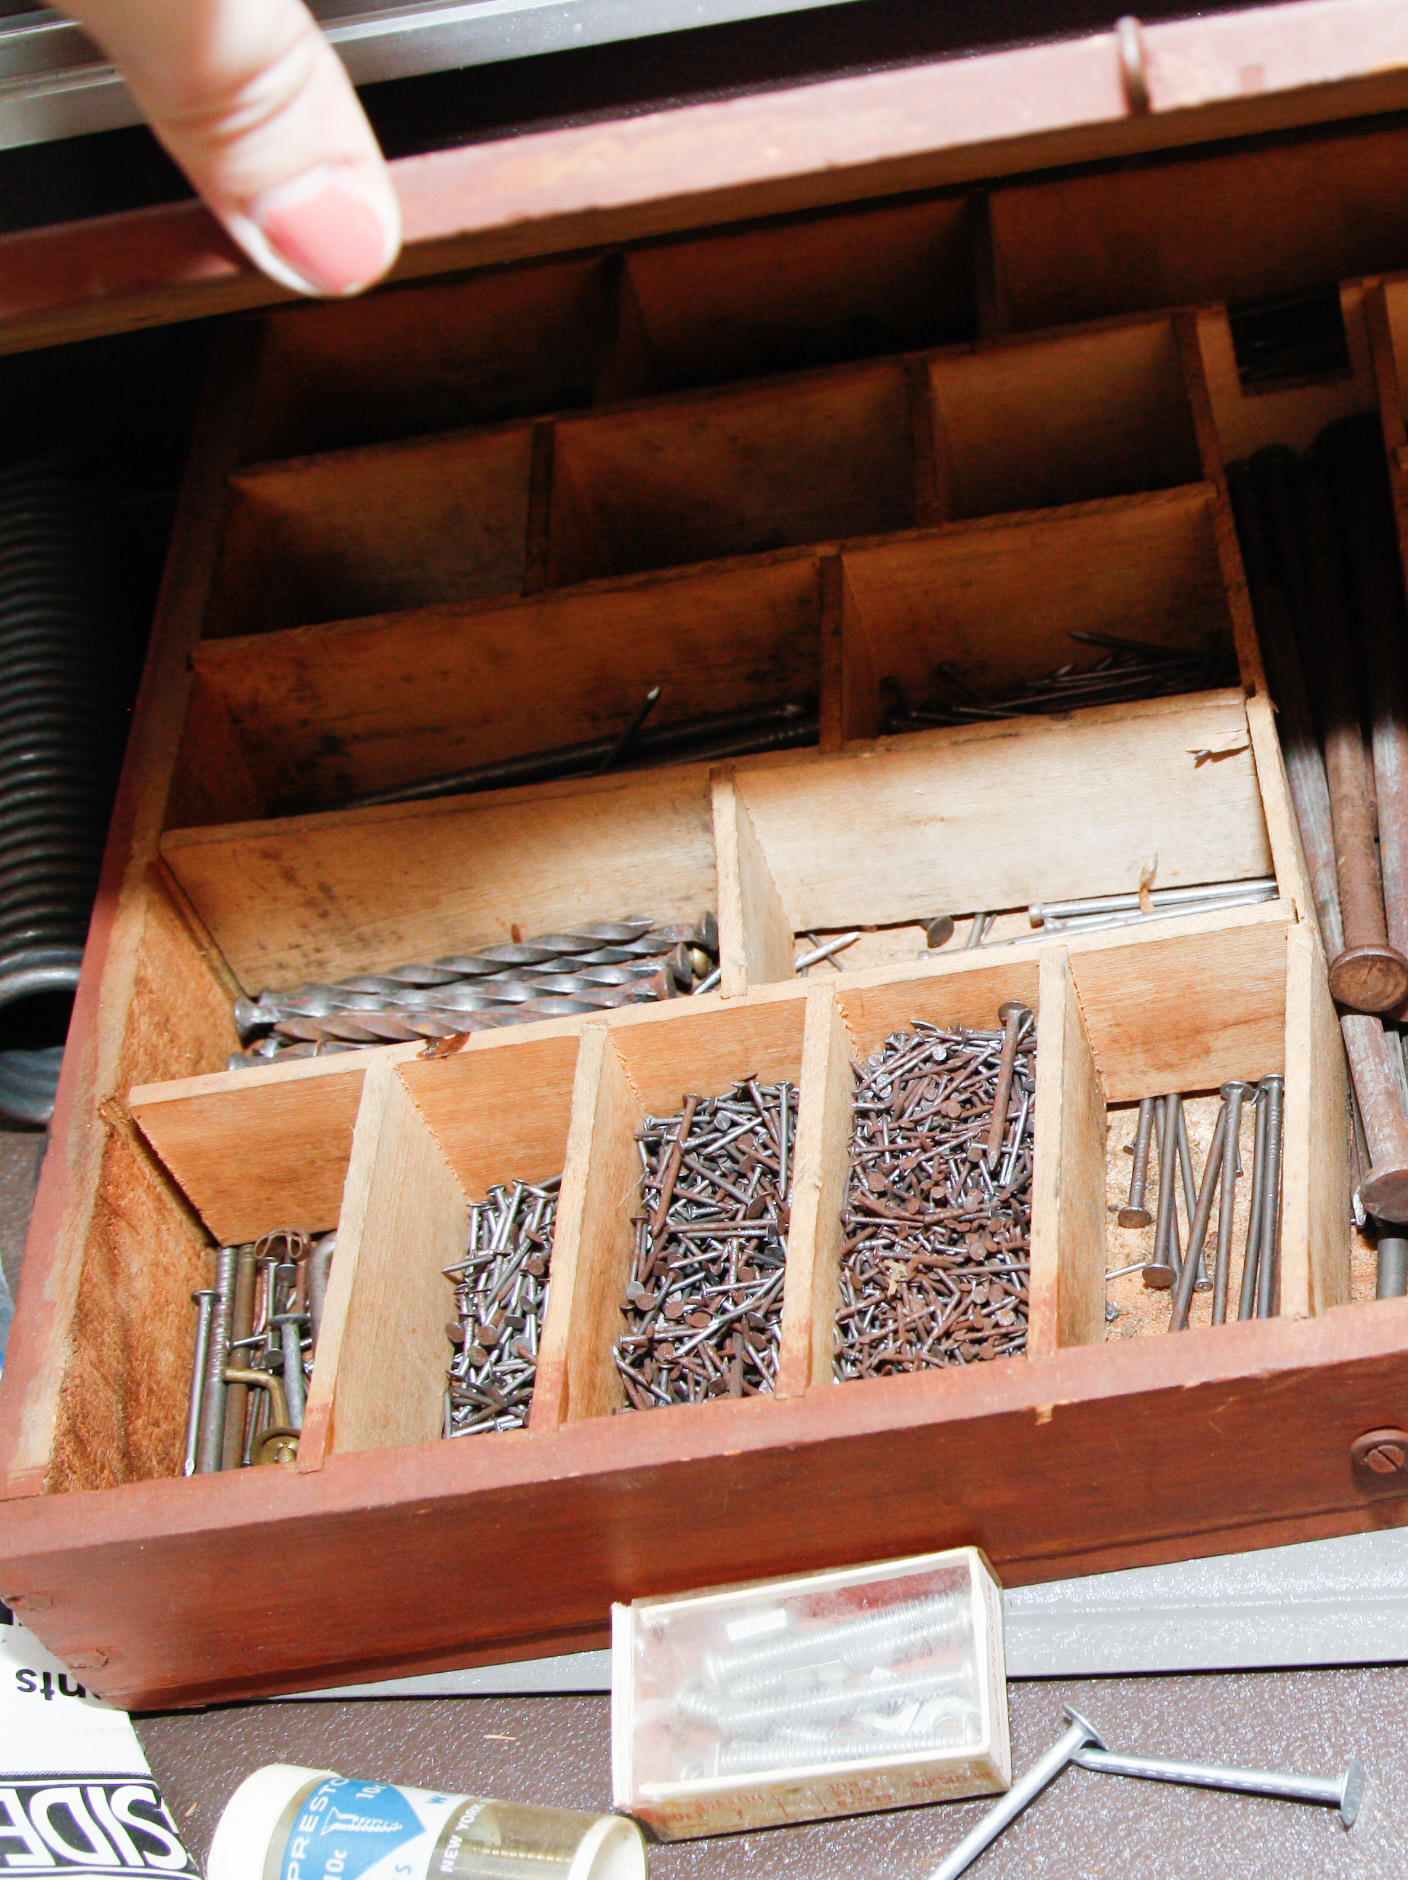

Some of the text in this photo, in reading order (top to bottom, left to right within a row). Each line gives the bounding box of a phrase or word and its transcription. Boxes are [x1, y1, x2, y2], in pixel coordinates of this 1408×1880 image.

[986, 1582, 996, 1637] STOVE
[989, 1639, 1000, 1705] PLATED
[441, 1803, 487, 1874] NEW YORK
